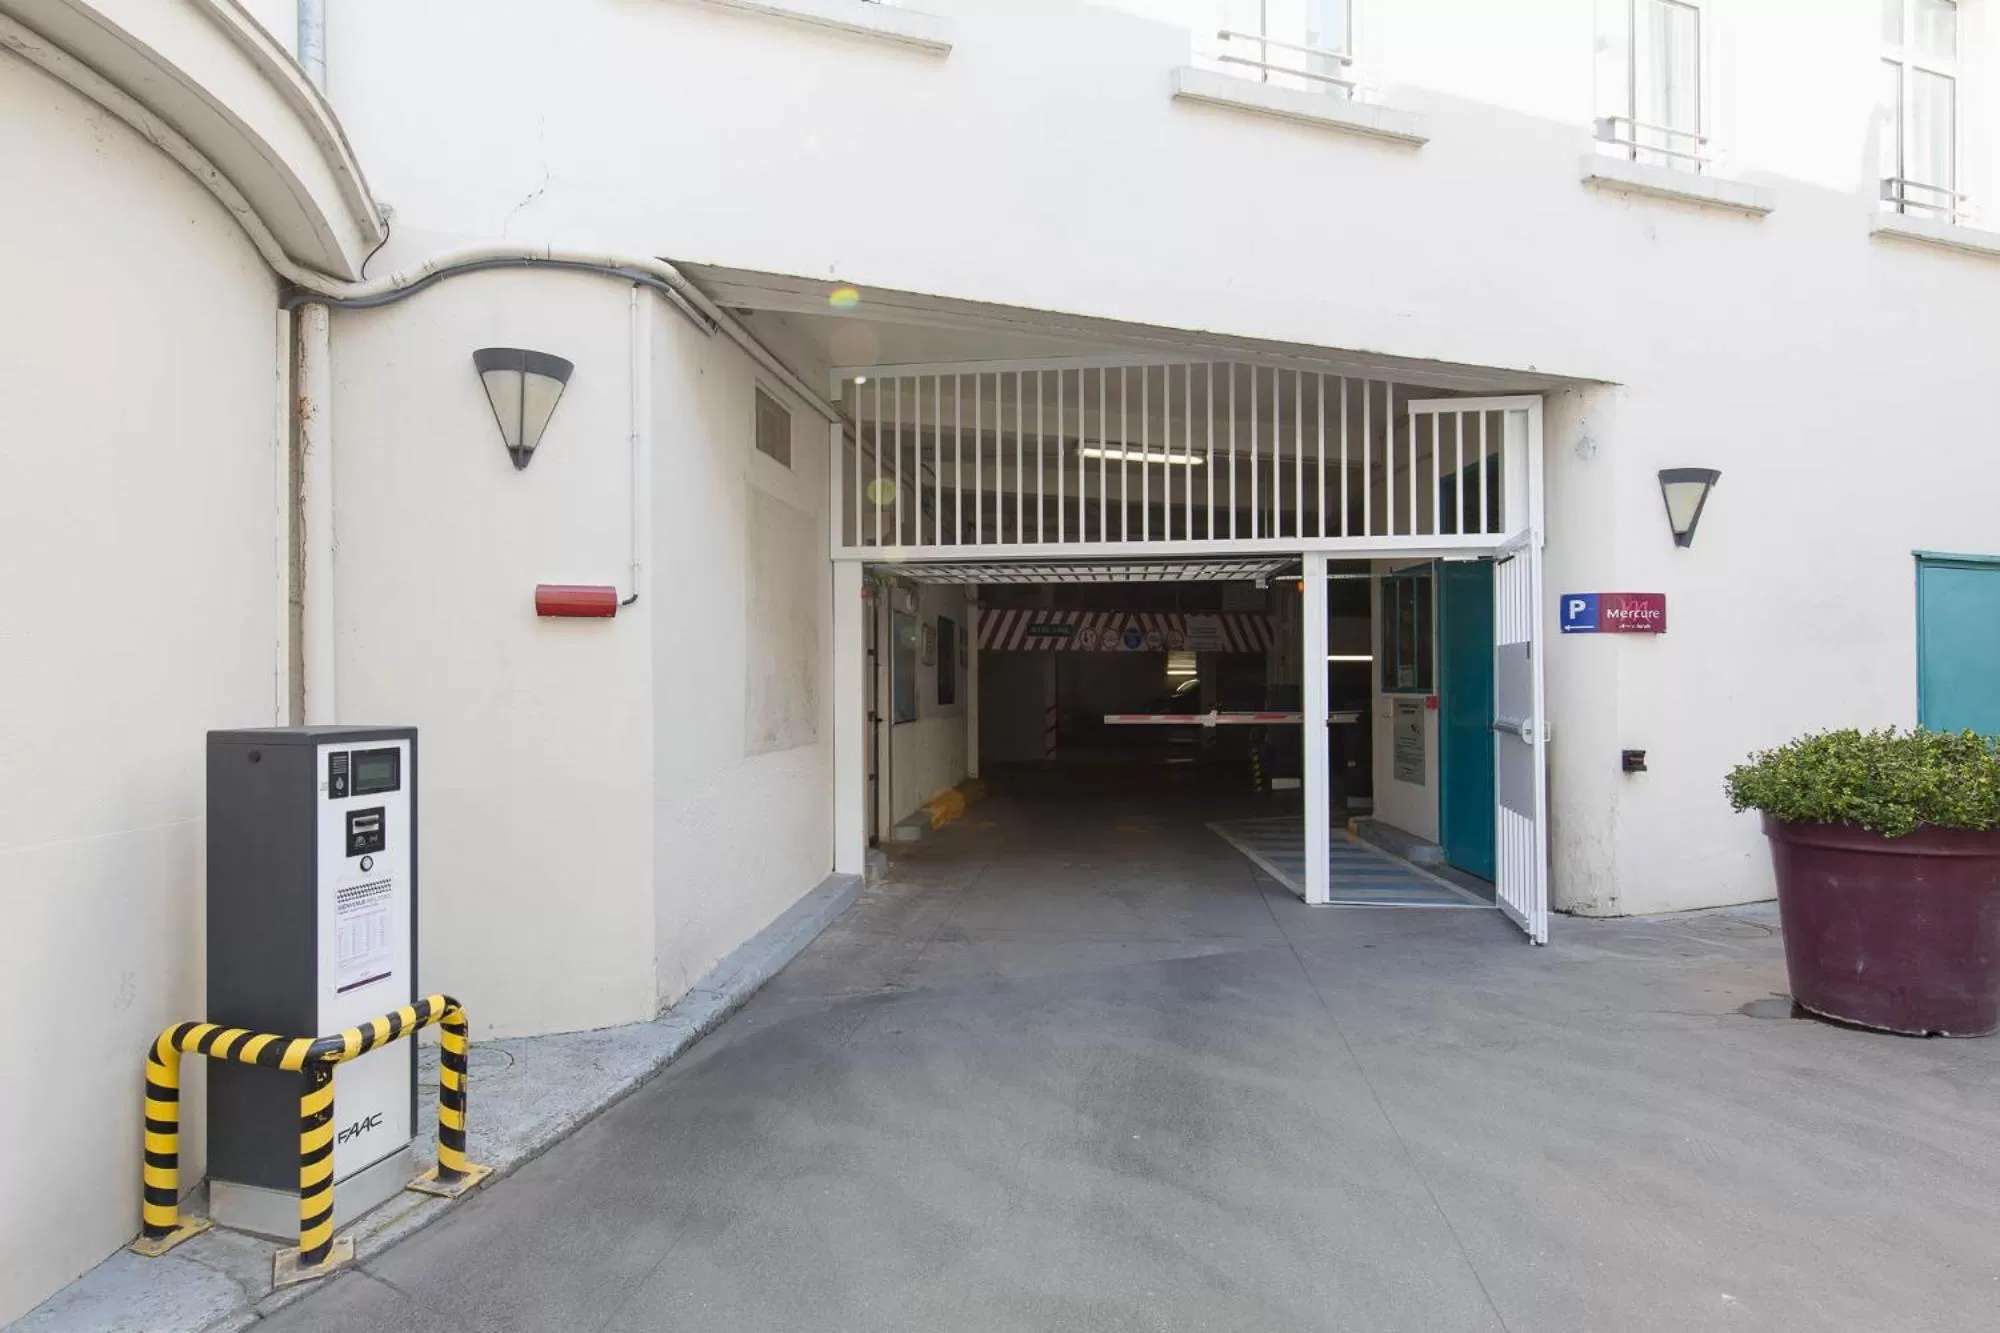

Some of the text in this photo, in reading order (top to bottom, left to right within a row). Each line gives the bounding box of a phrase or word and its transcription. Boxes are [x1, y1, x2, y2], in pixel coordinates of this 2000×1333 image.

[1569, 599, 1586, 620] P
[1606, 608, 1660, 619] Mercure
[338, 1112, 383, 1144] FAAC
